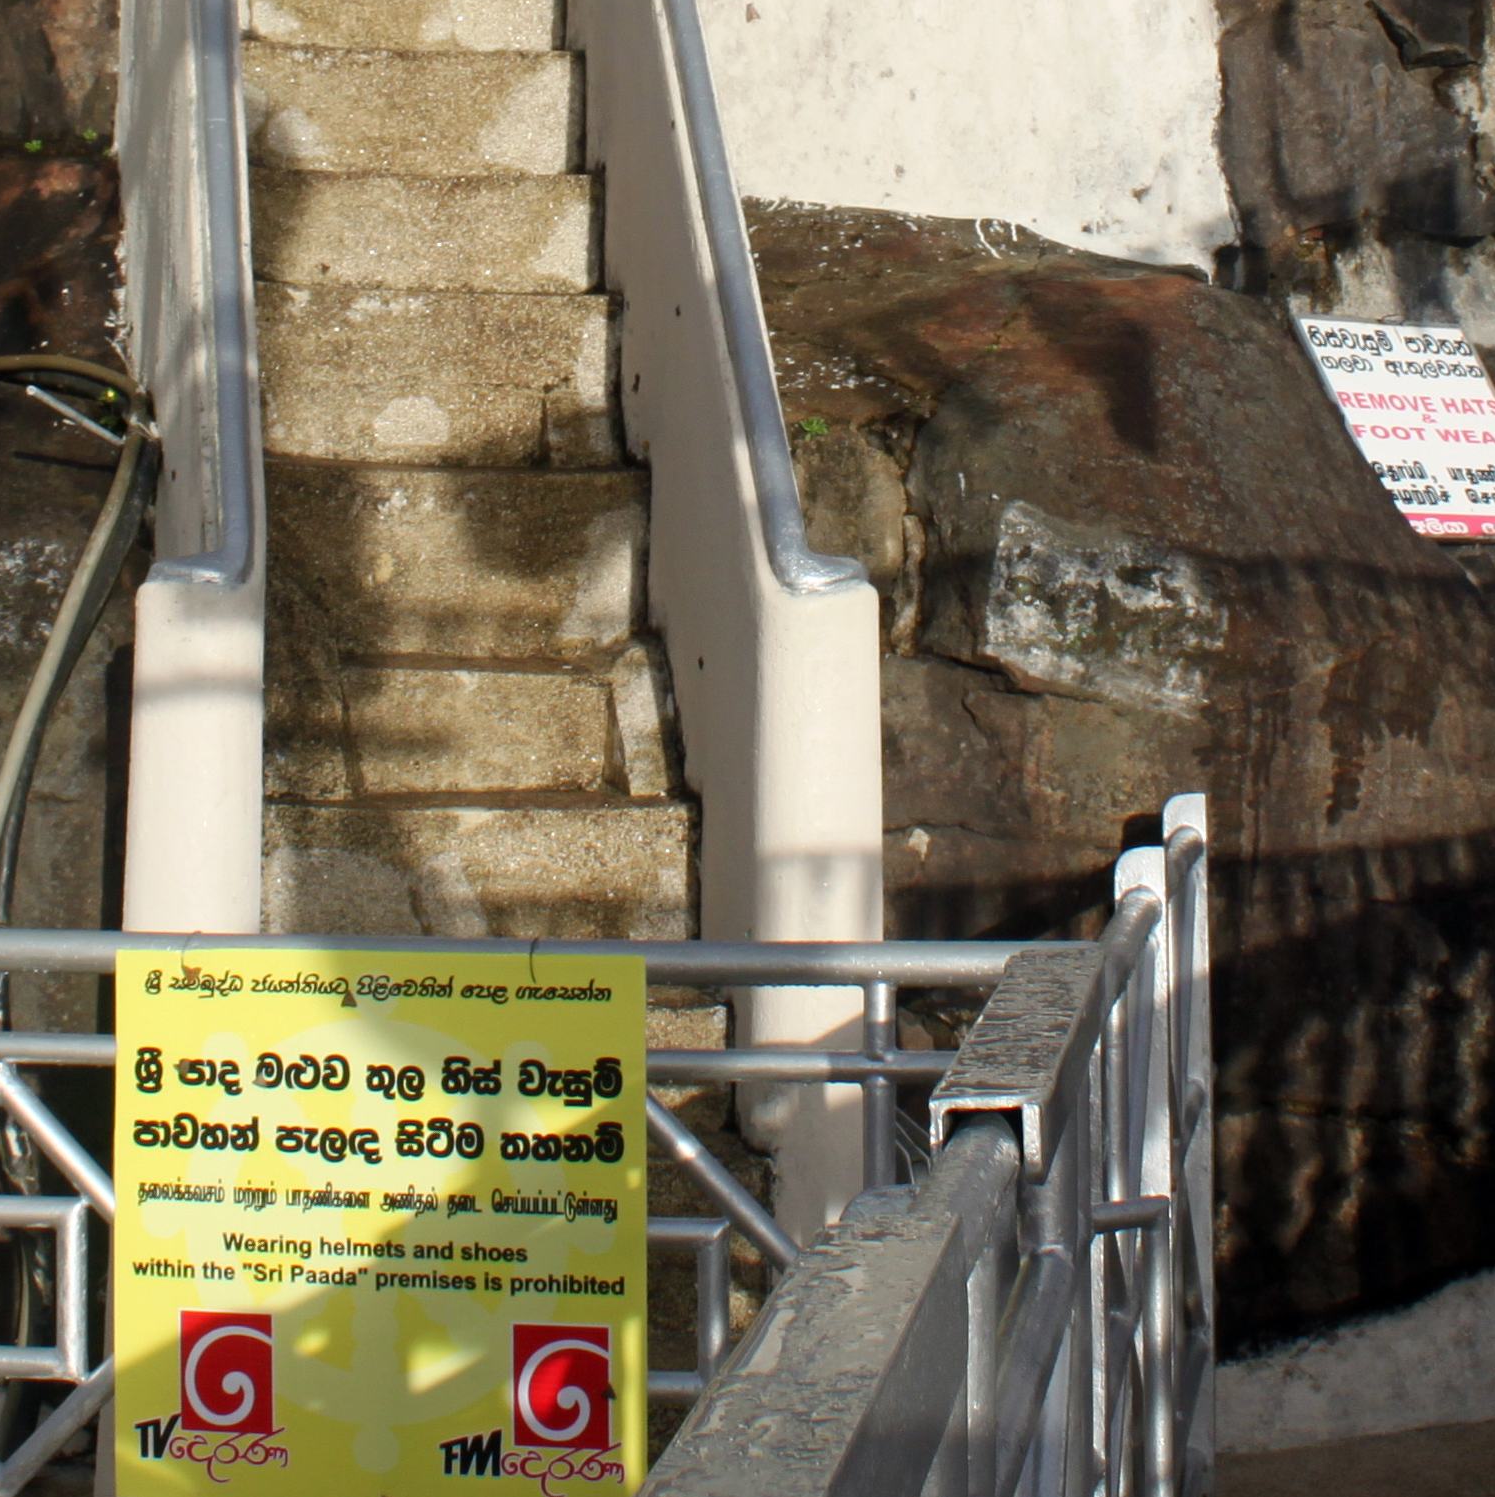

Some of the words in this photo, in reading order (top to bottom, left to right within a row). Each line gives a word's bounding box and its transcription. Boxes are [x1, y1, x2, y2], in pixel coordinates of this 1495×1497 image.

[1320, 354, 1373, 373] ගලවා
[1336, 391, 1438, 413] REMOVE
[1422, 413, 1437, 423] &
[1352, 424, 1427, 441] FOOT
[134, 1046, 163, 1093] ශ්‍රී
[181, 1058, 242, 1091] පාද
[253, 1052, 350, 1091] මළුව
[365, 1064, 425, 1101] තුල
[441, 1055, 501, 1095] හිස්
[517, 1056, 622, 1107] වැසුම්
[133, 1112, 259, 1151] පාවහන්
[394, 1116, 483, 1159] සිටීම
[499, 1121, 624, 1162] තහනම්
[223, 1232, 311, 1259] Wearing
[319, 1236, 405, 1257] helmets
[412, 1241, 454, 1260] and
[460, 1241, 527, 1262] shoes
[132, 1258, 194, 1278] within
[202, 1261, 235, 1280] the
[242, 1262, 282, 1282] "Sri
[290, 1264, 367, 1285] Paada"
[375, 1270, 476, 1291] premises
[483, 1271, 502, 1291] is
[510, 1274, 624, 1296] prohibited
[134, 1411, 186, 1460] TV
[438, 1427, 503, 1478] FM
